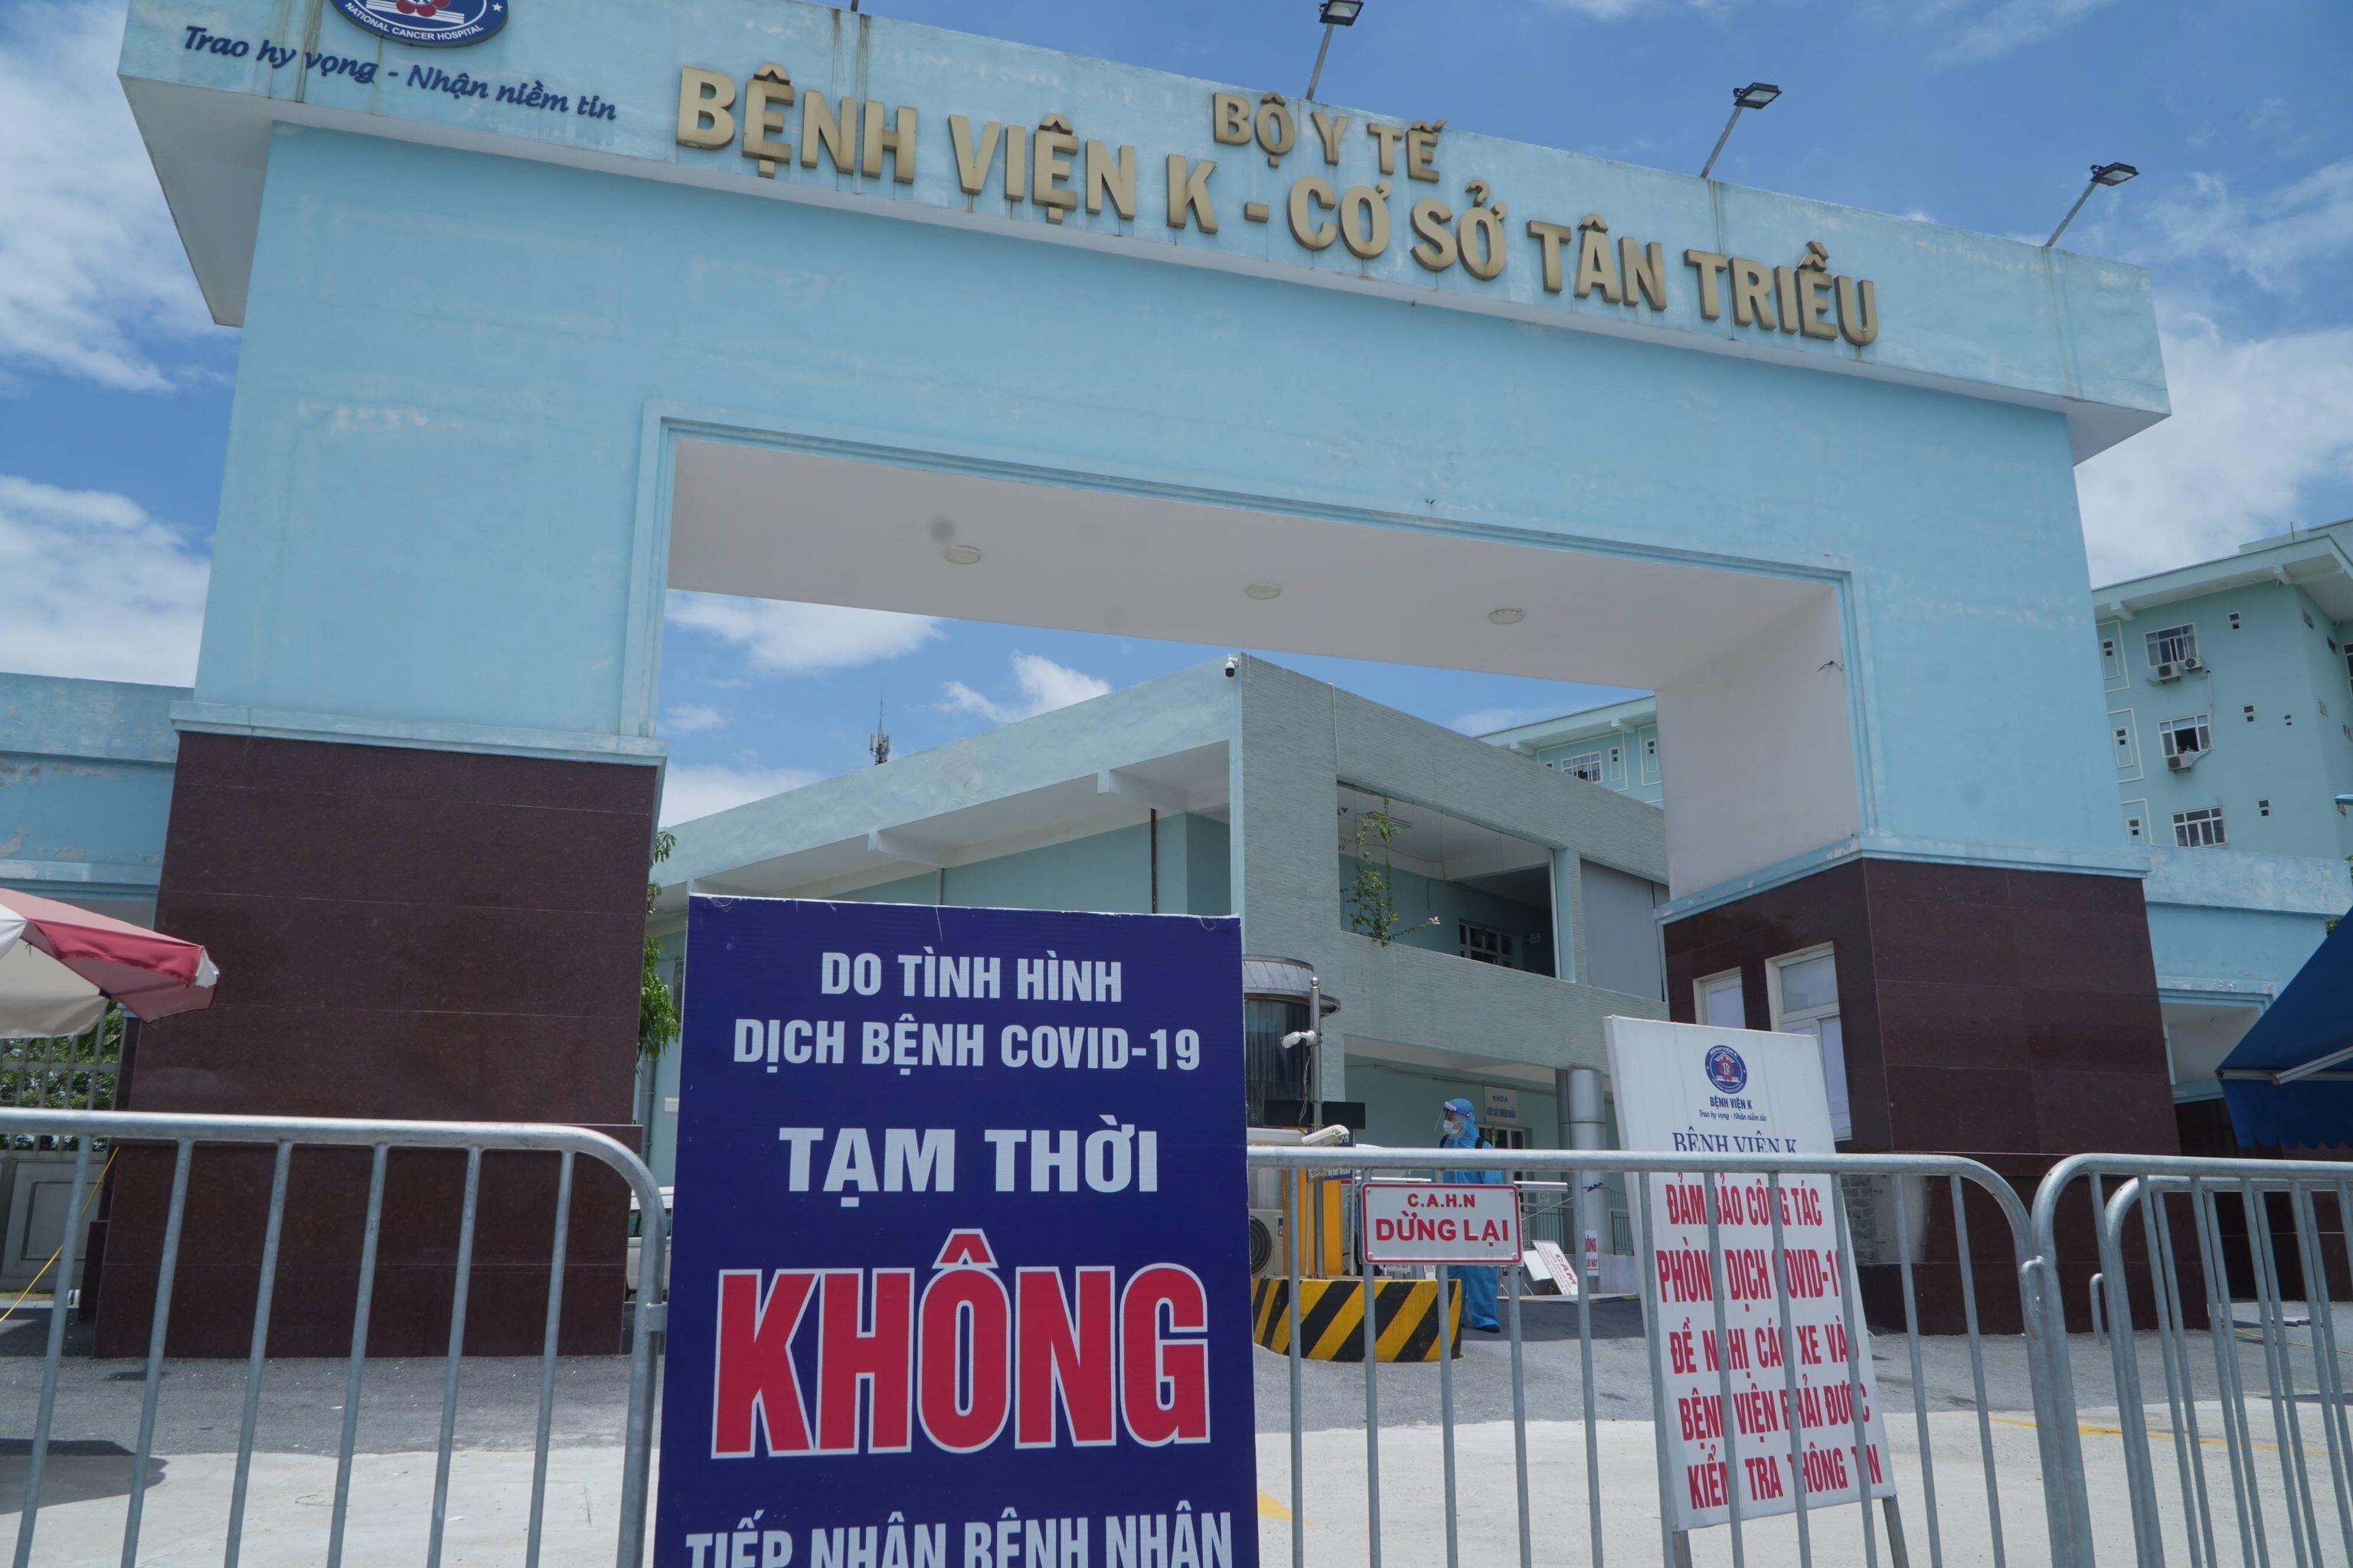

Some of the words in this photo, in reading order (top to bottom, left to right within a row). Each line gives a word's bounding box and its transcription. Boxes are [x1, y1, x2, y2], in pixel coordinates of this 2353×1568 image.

[345, 2, 390, 32] NATIONAL
[392, 27, 435, 41] CANCER
[437, 24, 484, 40] HOSPITAL
[185, 25, 250, 57] Trao
[256, 39, 297, 69] hy
[305, 51, 379, 83] vọng
[407, 64, 489, 100] Nhận
[495, 80, 569, 113] niềm
[577, 95, 616, 120] tin
[1212, 90, 1295, 168] BỘ
[1310, 110, 1351, 165] Y
[1367, 117, 1449, 184] TẾ
[675, 61, 917, 185] BỆNH
[949, 113, 1136, 225] VIỆN
[1166, 153, 1218, 234] K
[1286, 175, 1393, 260] CƠ
[1410, 178, 1509, 281] SỞ
[1527, 212, 1668, 312] TÂN
[1684, 240, 1878, 347] TRIỀU
[821, 952, 881, 995] DO
[897, 946, 1001, 999] TÌNH
[1017, 950, 1122, 1003] HÌNH
[734, 1018, 845, 1073] DỊCH
[861, 1014, 985, 1075] BỆNH
[1000, 1024, 1201, 1071] COVID-19
[1709, 1095, 1729, 1109] BỆNH
[1730, 1096, 1746, 1111] VIỆN
[1747, 1099, 1753, 1109] K
[779, 1127, 956, 1207] TẠM
[984, 1114, 1159, 1193] THỜI
[1785, 1139, 1797, 1153] K
[1375, 1210, 1456, 1241] DỪNG
[1463, 1219, 1508, 1246] LẠI
[1407, 1193, 1475, 1207] C.A.H.N
[1665, 1171, 1708, 1225] ĐẢM
[1746, 1178, 1791, 1226] CÔG
[1790, 1180, 1822, 1227] TÁC
[1655, 1236, 1717, 1303] PHÒN
[1724, 1249, 1772, 1312] DỊCH
[711, 1228, 1211, 1460] KHÔNG
[1669, 1317, 1697, 1374] ĐỀ
[1702, 1327, 1751, 1378] NHỊ
[1796, 1325, 1822, 1365] XE
[1824, 1315, 1859, 1364] VÀ
[1733, 1382, 1778, 1443] VIỆN
[1744, 1455, 1783, 1501] TRA
[685, 1509, 793, 1568] TIẾP
[1106, 1500, 1233, 1568] NHÂN
